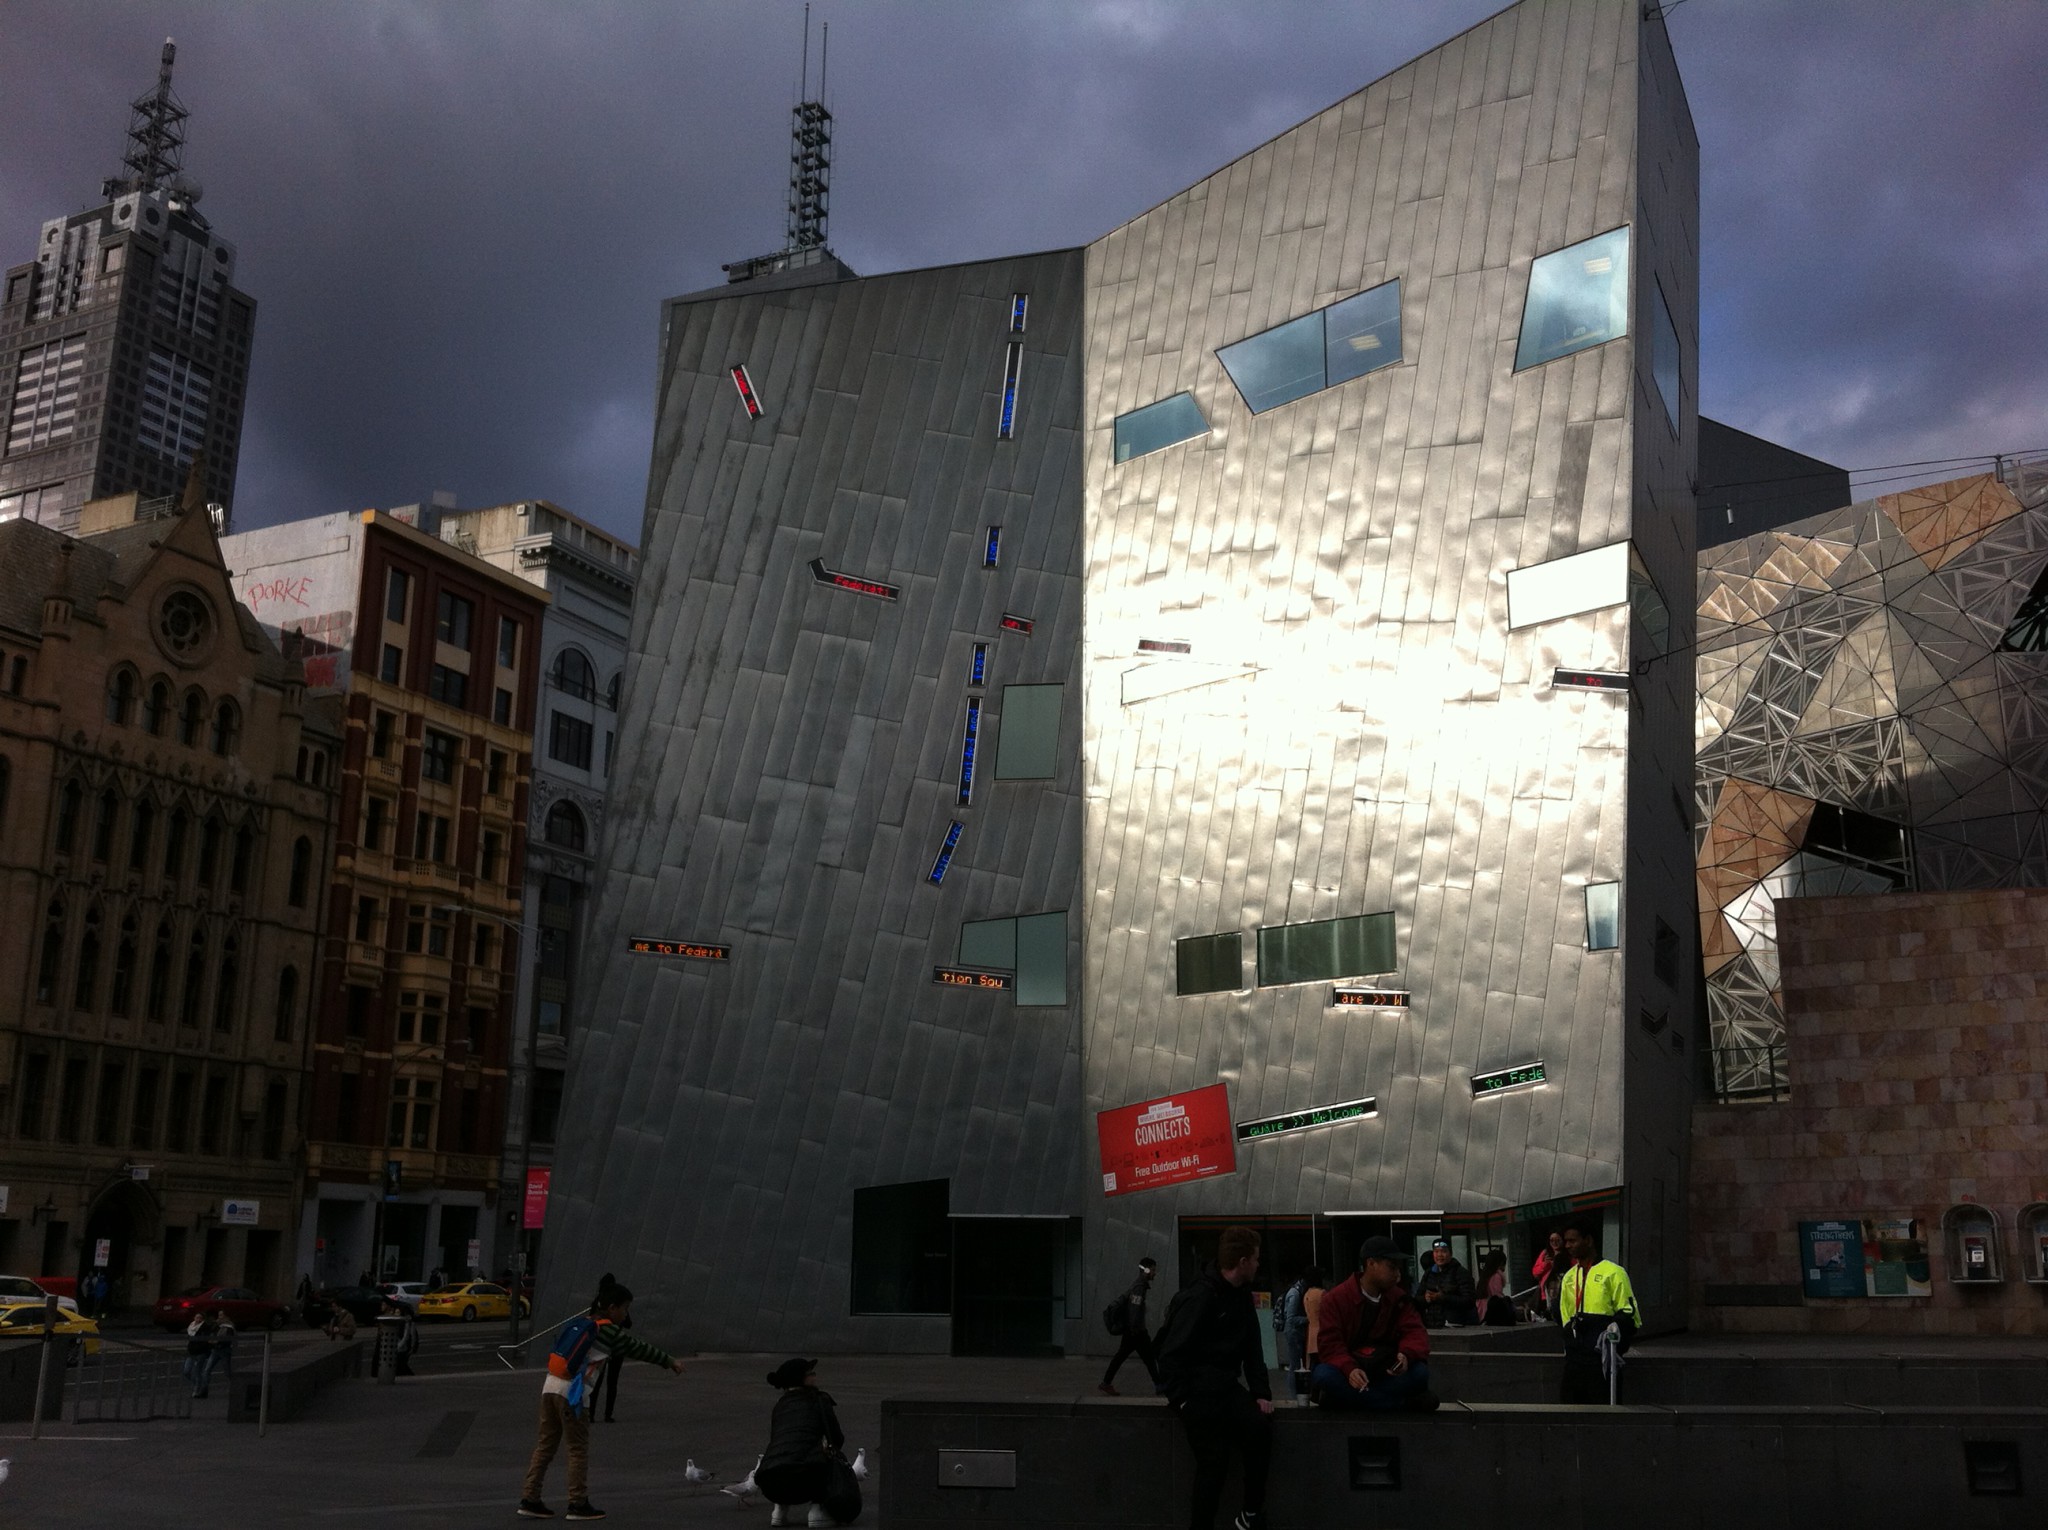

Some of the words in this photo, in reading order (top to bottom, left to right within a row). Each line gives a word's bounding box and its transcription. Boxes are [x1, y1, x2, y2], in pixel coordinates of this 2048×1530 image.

[942, 972, 973, 984] tion
[979, 974, 1004, 988] Squ
[1341, 993, 1364, 1005] are
[1485, 1078, 1504, 1089] to
[1509, 1067, 1544, 1084] Fede
[1310, 1105, 1365, 1124] Welcome
[1135, 1116, 1191, 1146] CONNECTS
[1135, 1166, 1151, 1178] Free
[1152, 1160, 1180, 1173] Outdoor
[1181, 1154, 1200, 1168] Wi-Fi
